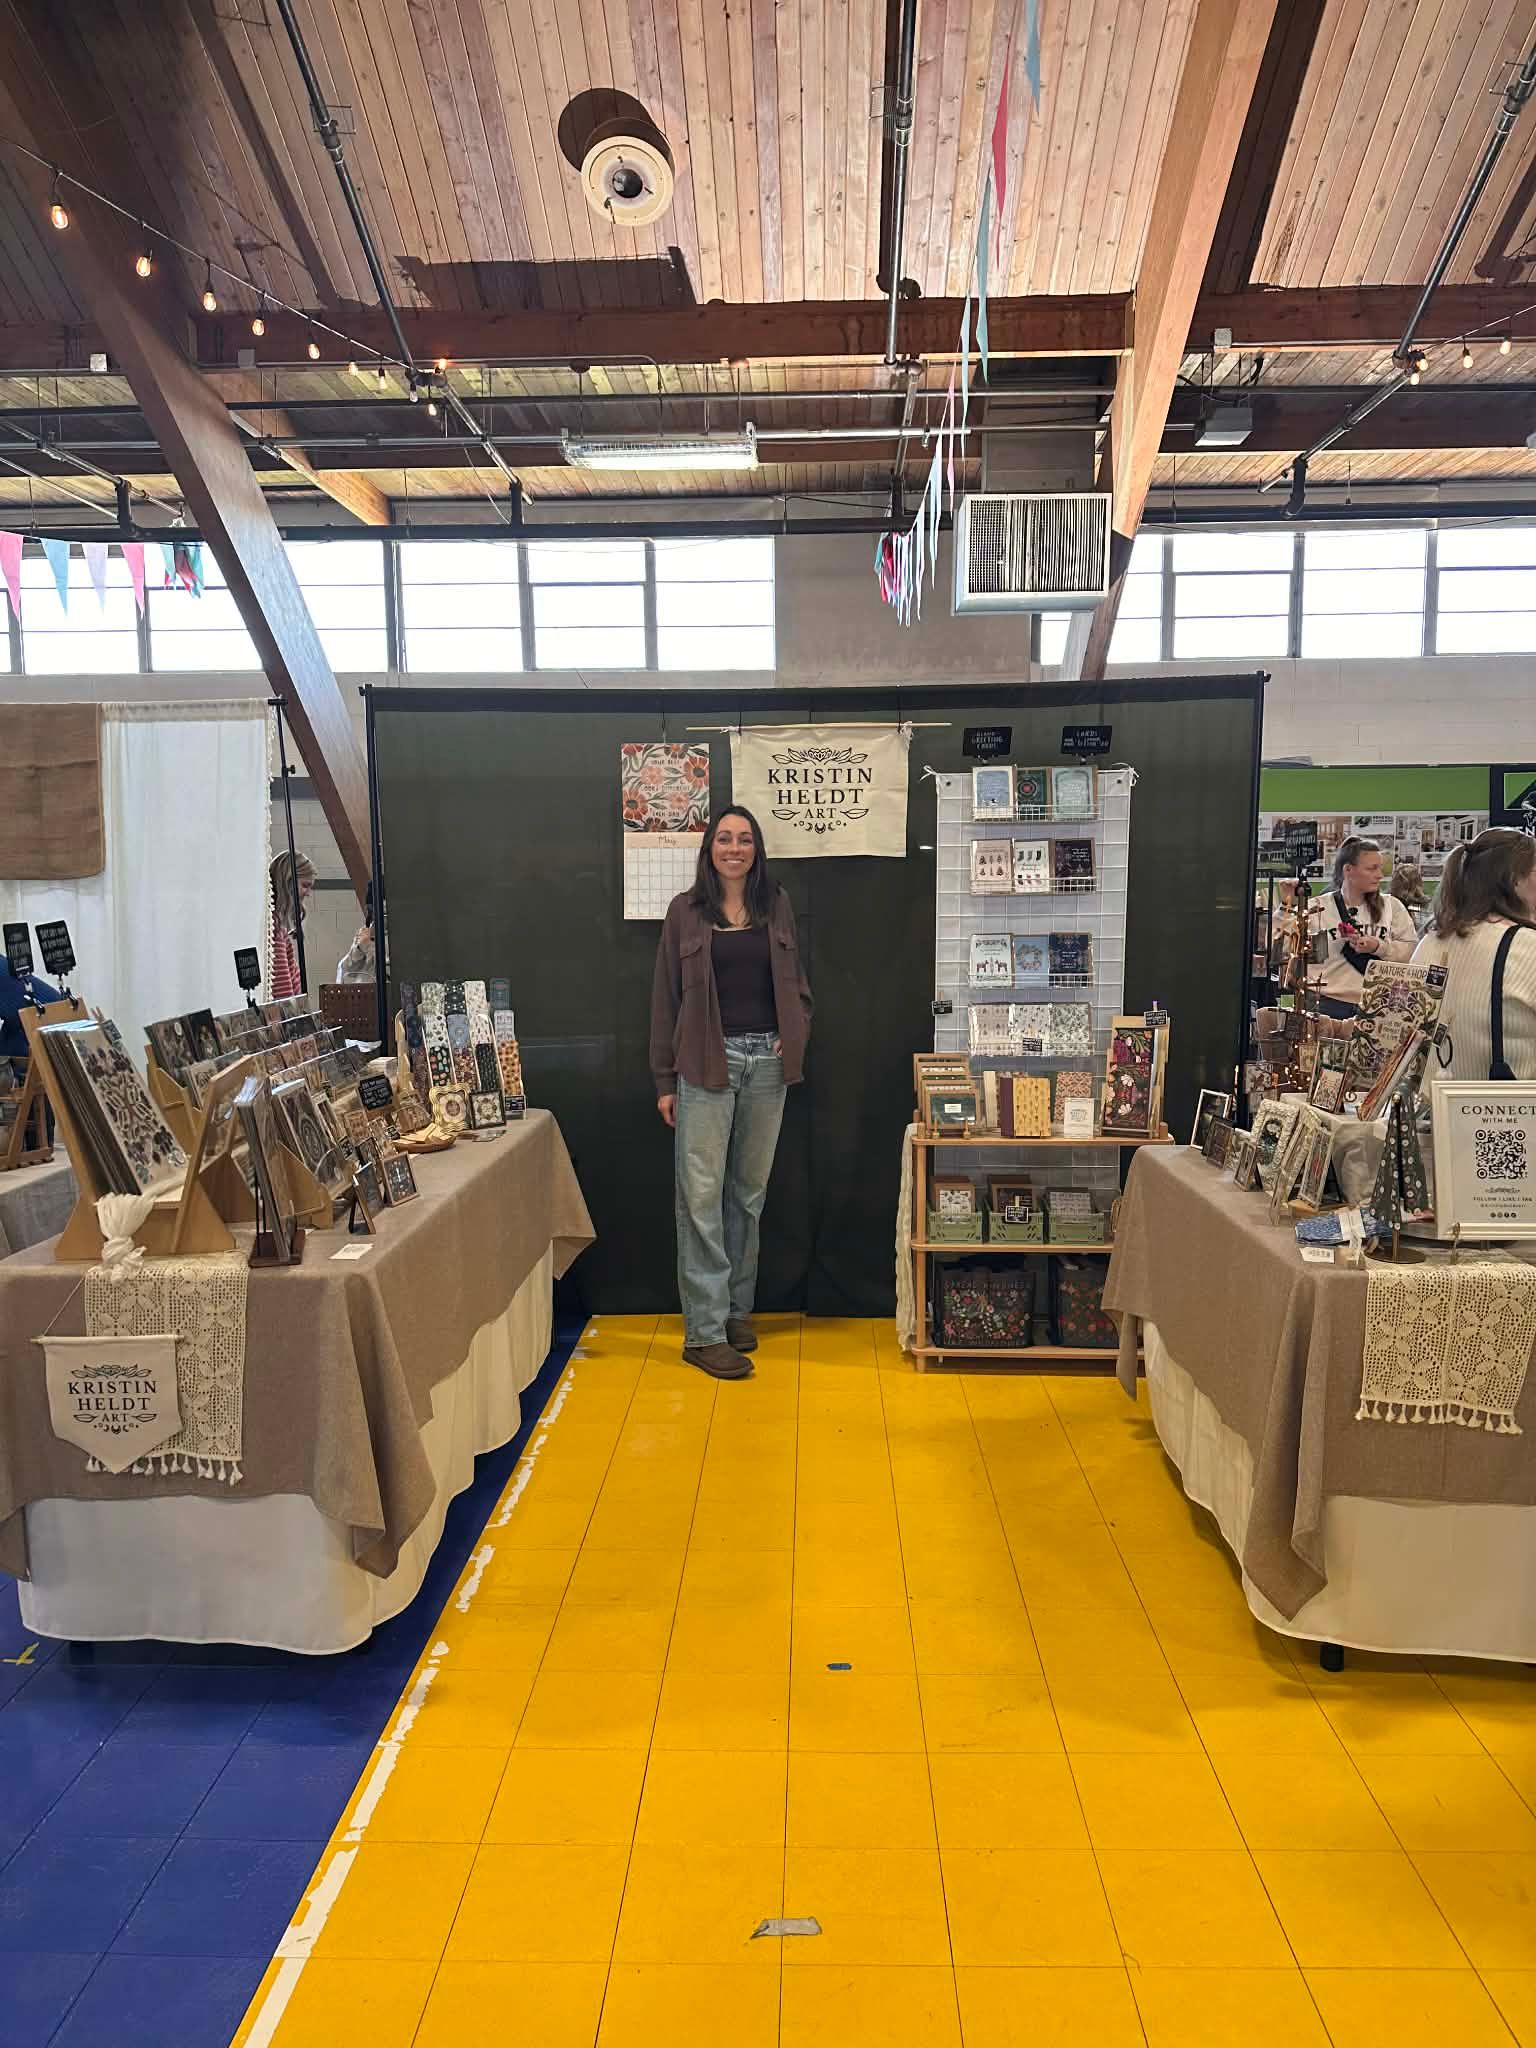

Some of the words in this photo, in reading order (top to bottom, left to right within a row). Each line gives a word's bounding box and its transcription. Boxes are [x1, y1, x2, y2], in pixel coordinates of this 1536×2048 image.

[767, 767, 873, 785] KRISTIN
[776, 788, 864, 805] HELDT
[804, 807, 837, 819] ART
[1379, 965, 1407, 978] NATURE
[1461, 1105, 1536, 1115] CONNECT
[67, 1380, 157, 1395] KRISTIN
[77, 1397, 152, 1411] HELDT
[101, 1413, 129, 1423] ART
